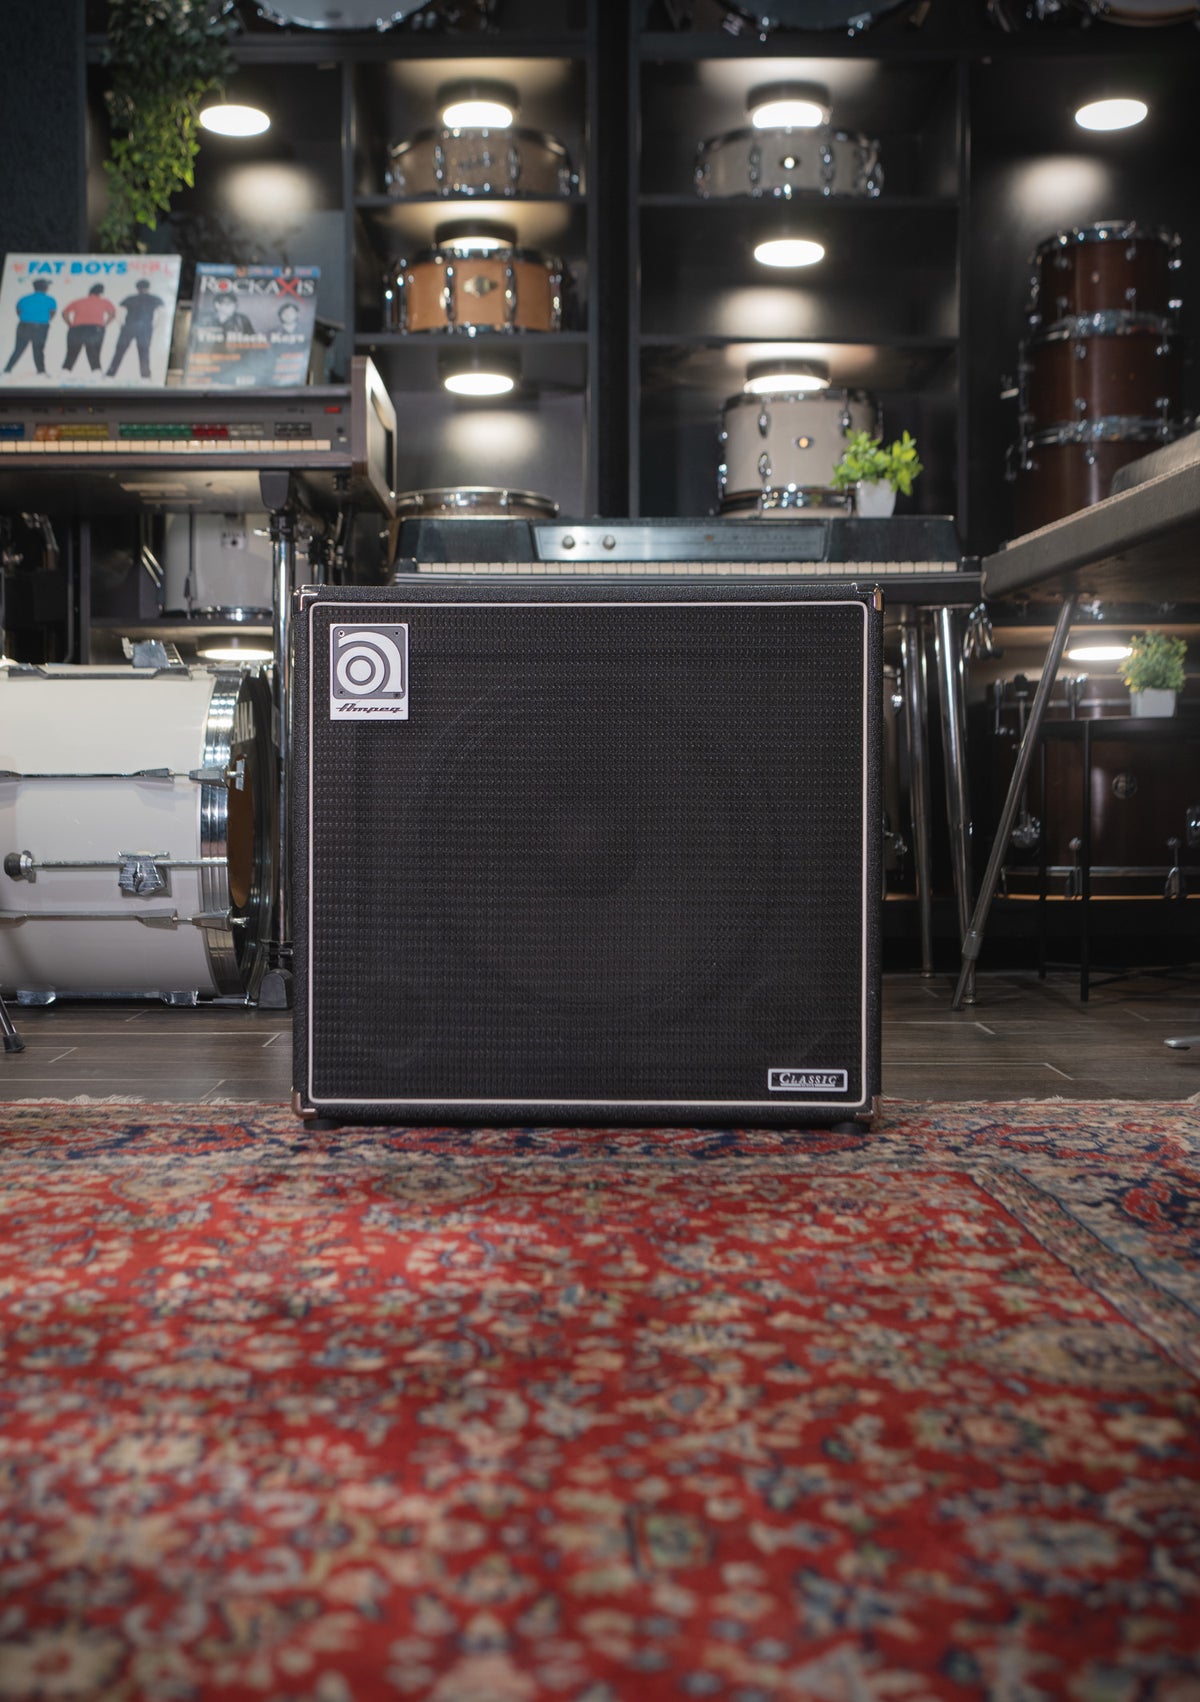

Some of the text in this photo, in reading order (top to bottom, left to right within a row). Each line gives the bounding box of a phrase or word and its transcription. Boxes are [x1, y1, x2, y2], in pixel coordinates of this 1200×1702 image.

[28, 260, 65, 274] FAT
[70, 260, 128, 275] BOYS
[198, 332, 225, 343] The
[336, 701, 404, 713] Ampeg
[230, 700, 257, 745] AMA
[779, 1072, 837, 1085] CLASSIC
